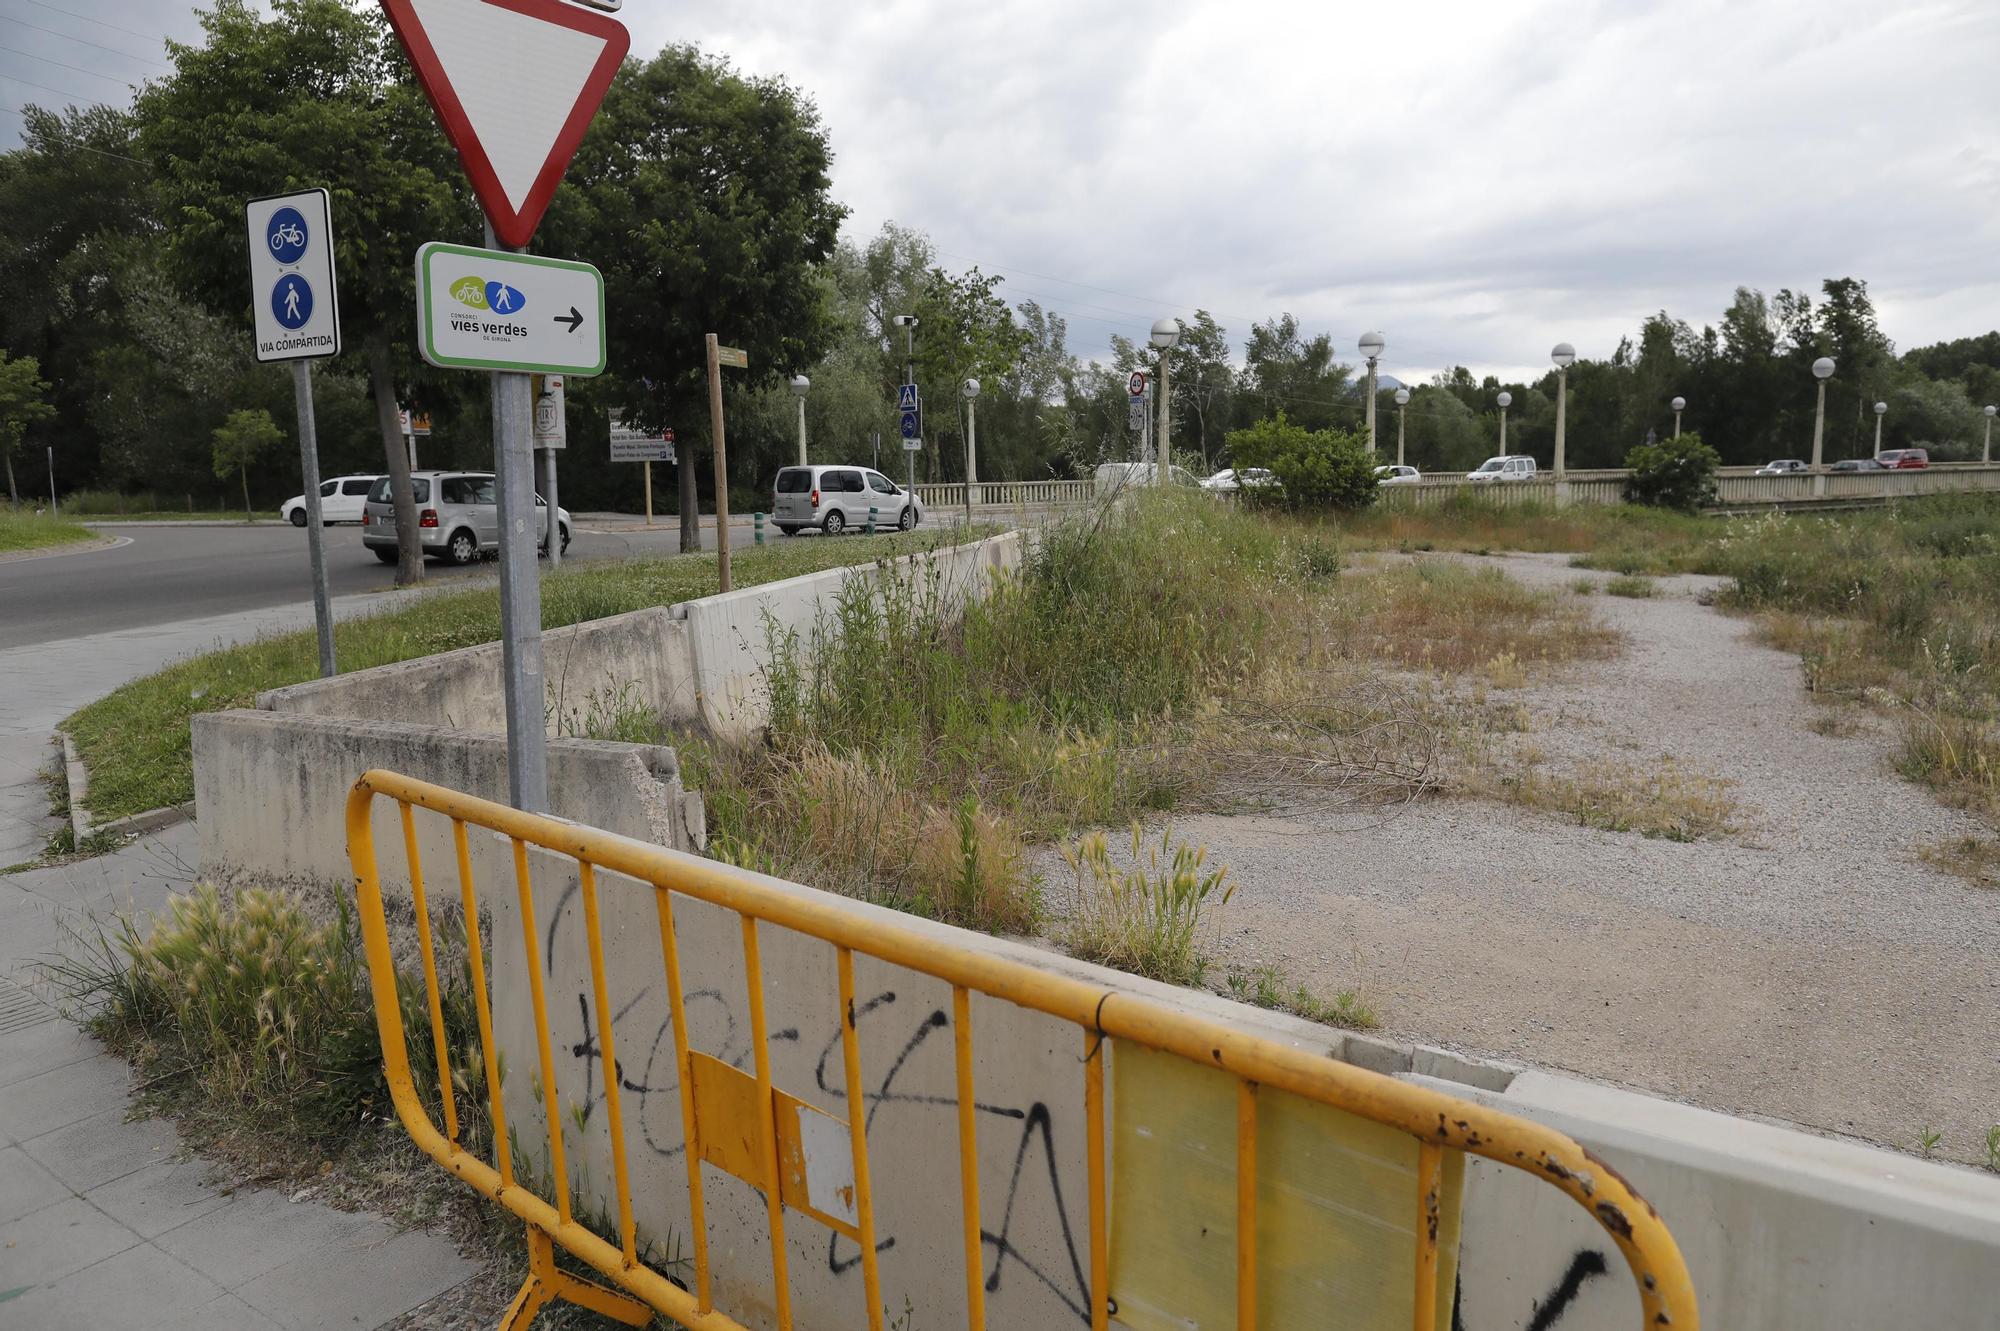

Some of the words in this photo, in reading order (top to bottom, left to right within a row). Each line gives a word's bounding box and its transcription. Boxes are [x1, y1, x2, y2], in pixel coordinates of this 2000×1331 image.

[451, 320, 479, 332] vies
[482, 323, 527, 337] verdes
[260, 342, 274, 353] VIA
[275, 335, 333, 351] COMPARTIDA
[1132, 379, 1141, 387] 40
